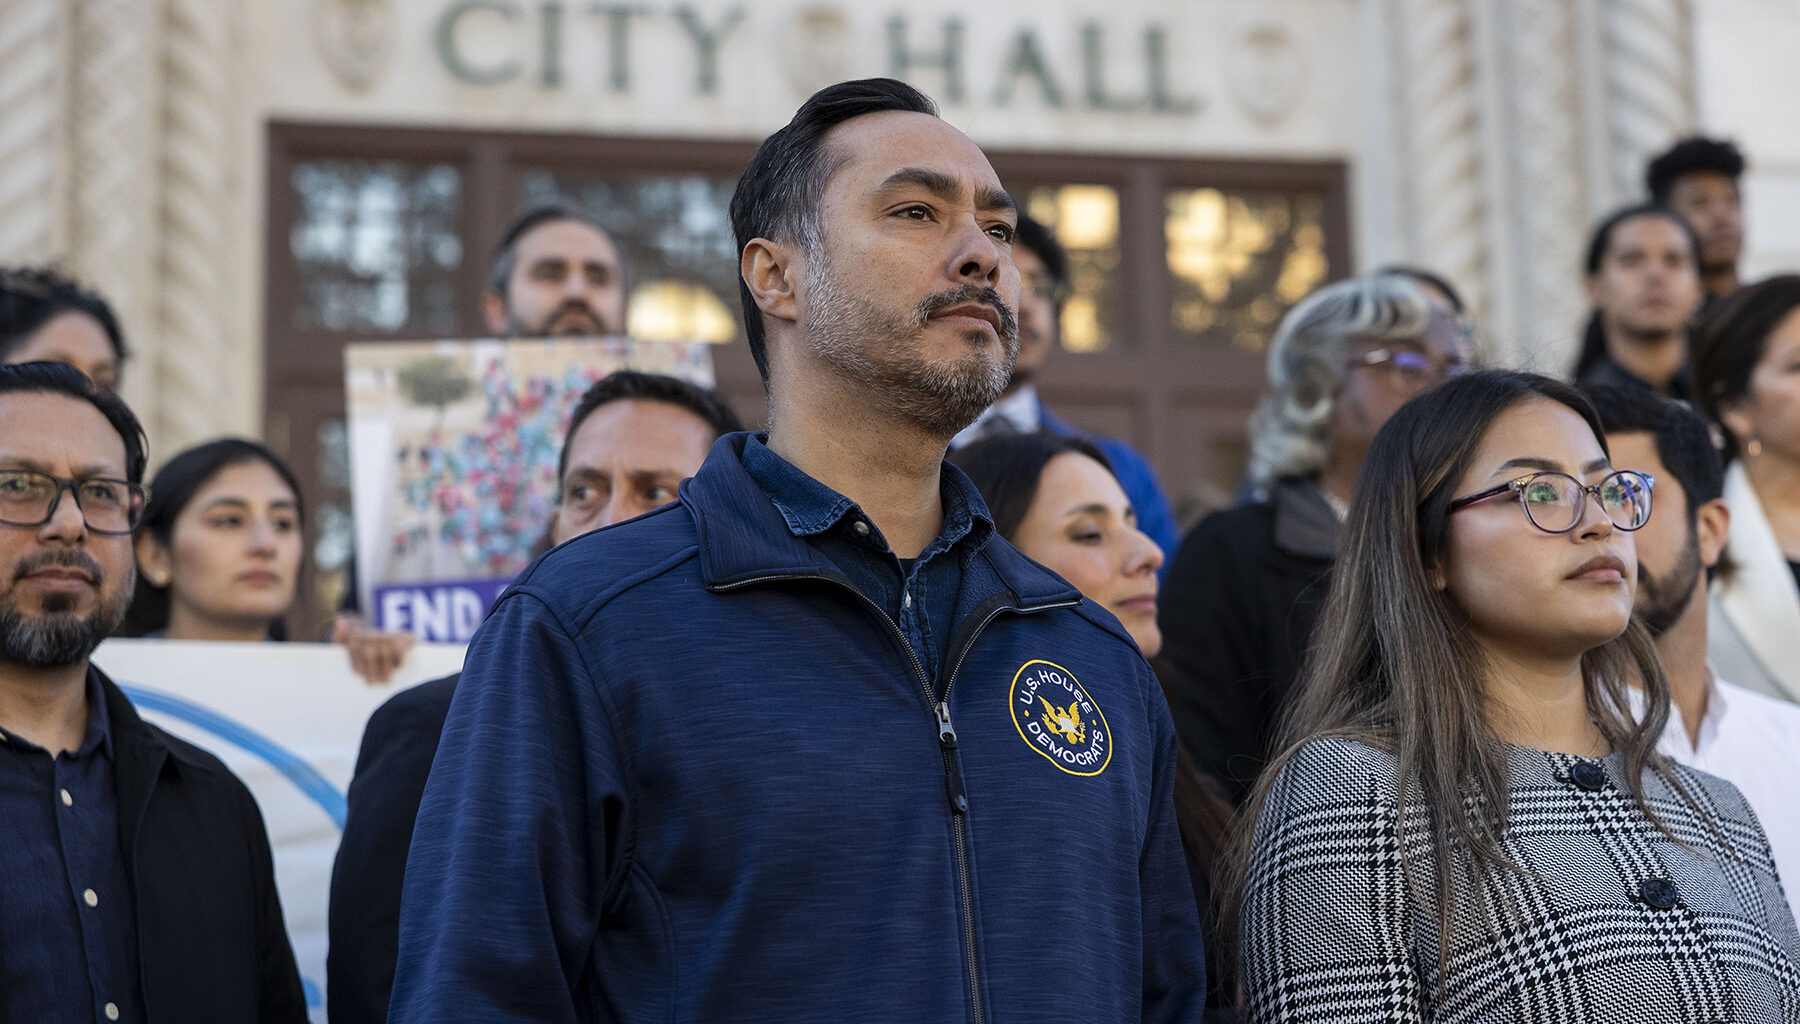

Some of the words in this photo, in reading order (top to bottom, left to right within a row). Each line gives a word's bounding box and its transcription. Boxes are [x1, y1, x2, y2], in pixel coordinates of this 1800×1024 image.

[435, 0, 747, 93] CITY
[887, 16, 1208, 115] HALL
[382, 587, 483, 641] END
[1020, 677, 1040, 705] U.S.
[1038, 670, 1093, 714] HOUSE
[1027, 721, 1104, 765] DEMOCRATS
